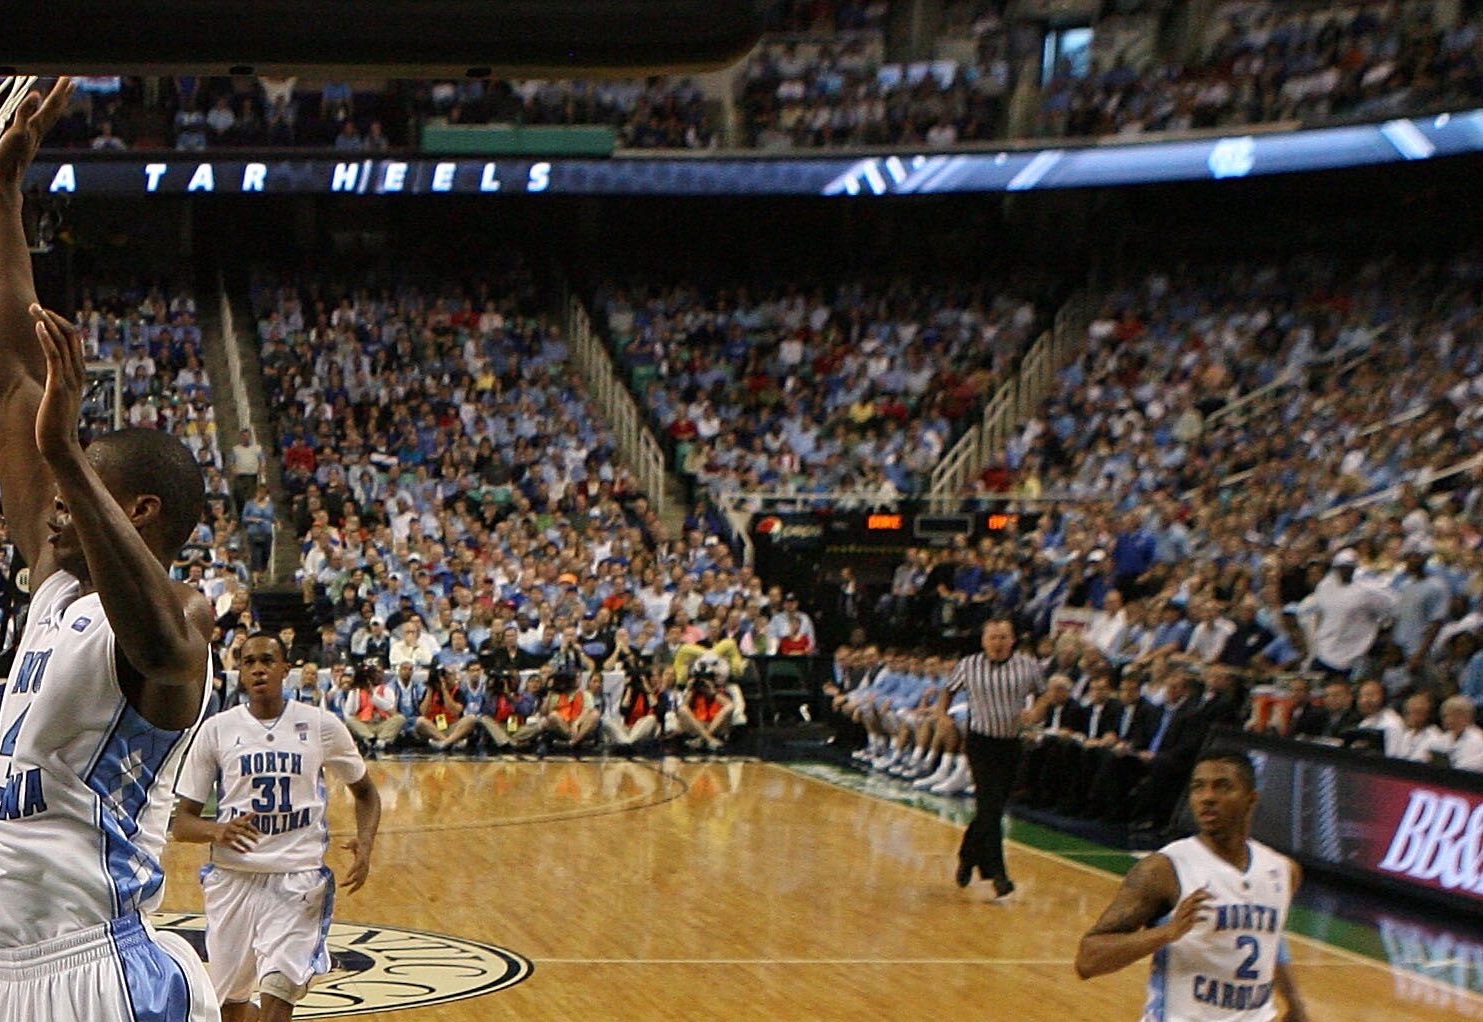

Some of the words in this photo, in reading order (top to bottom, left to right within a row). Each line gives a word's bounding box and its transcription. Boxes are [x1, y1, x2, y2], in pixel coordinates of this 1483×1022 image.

[145, 162, 267, 192] TAR
[331, 162, 552, 192] HEELS
[239, 752, 303, 776] NORTH
[251, 776, 293, 813] 31
[1235, 935, 1260, 980] 2
